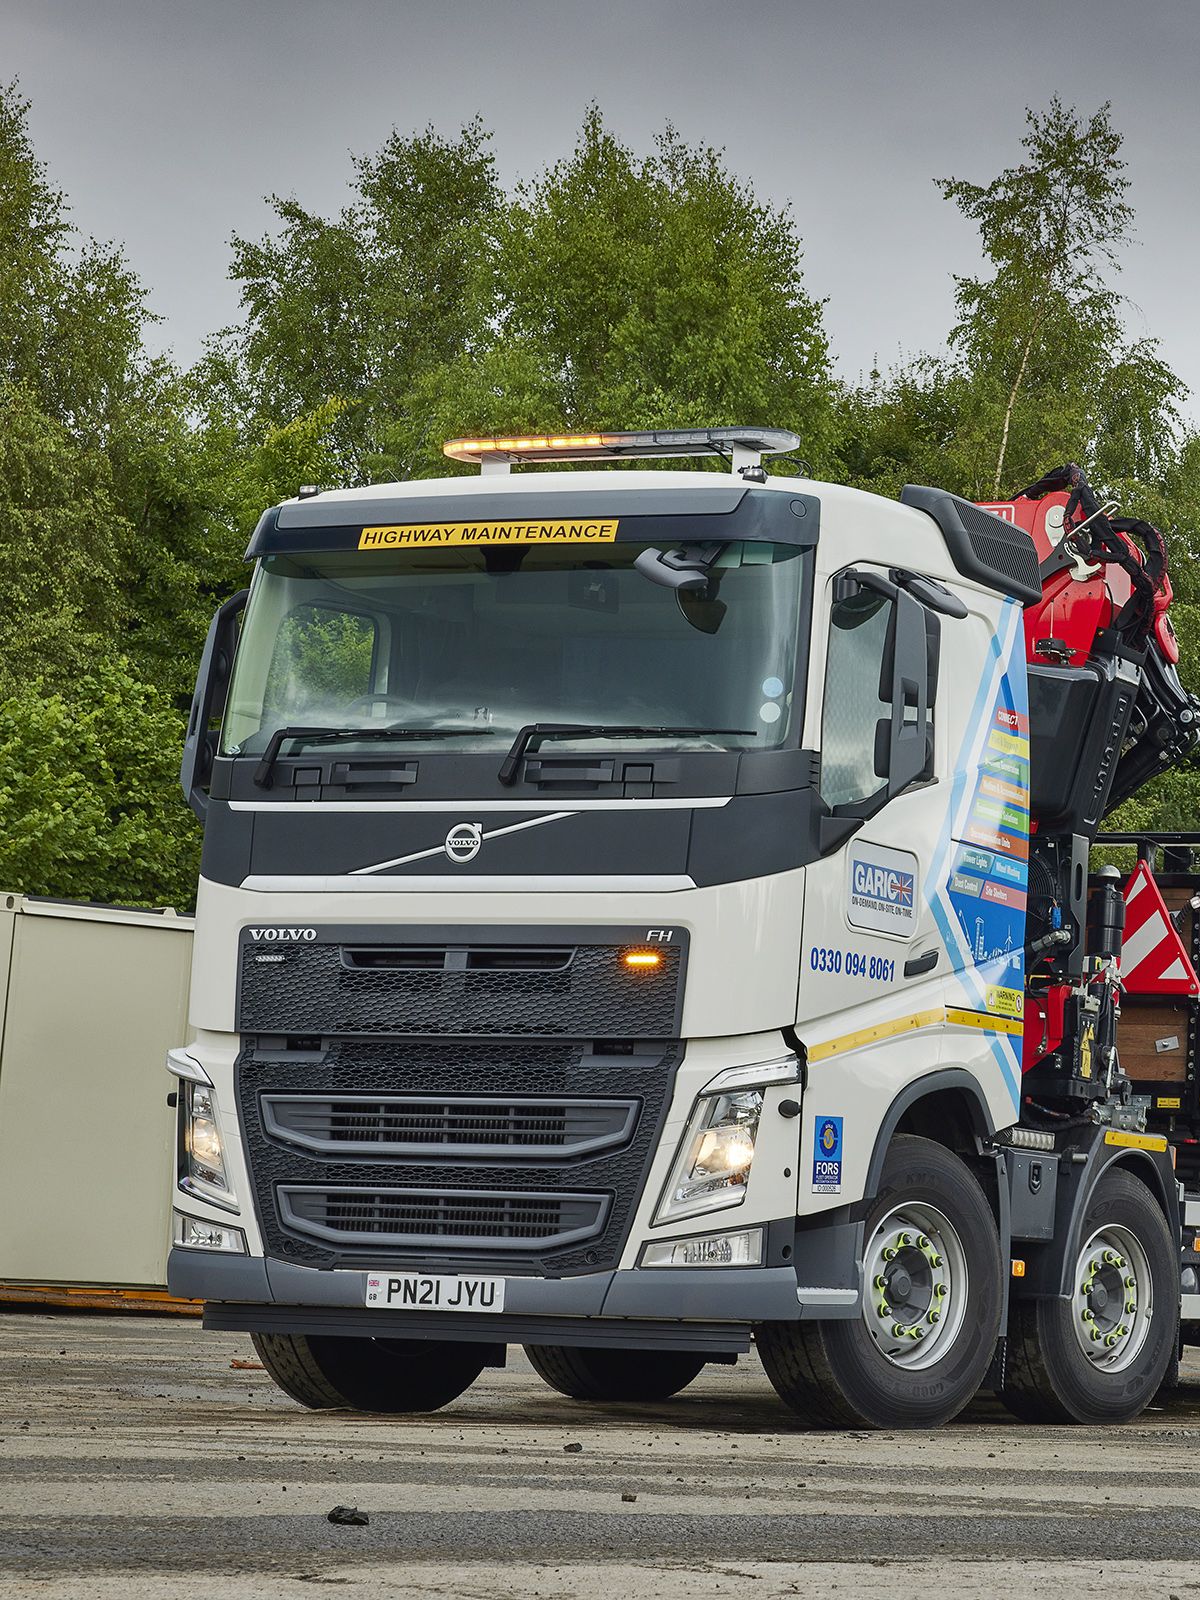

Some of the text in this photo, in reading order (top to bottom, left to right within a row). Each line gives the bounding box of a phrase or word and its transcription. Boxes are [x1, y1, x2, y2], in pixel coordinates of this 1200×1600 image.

[363, 524, 613, 545] HIGHWAY MAINTENANCE
[976, 855, 988, 868] Lights
[854, 864, 899, 900] GARIC
[249, 928, 317, 941] VOLVO
[646, 930, 673, 942] FH
[810, 947, 895, 982] 0330 094 8061
[815, 1161, 839, 1175] FORS
[368, 1293, 378, 1301] GB
[386, 1278, 495, 1307] PN21 JYU
